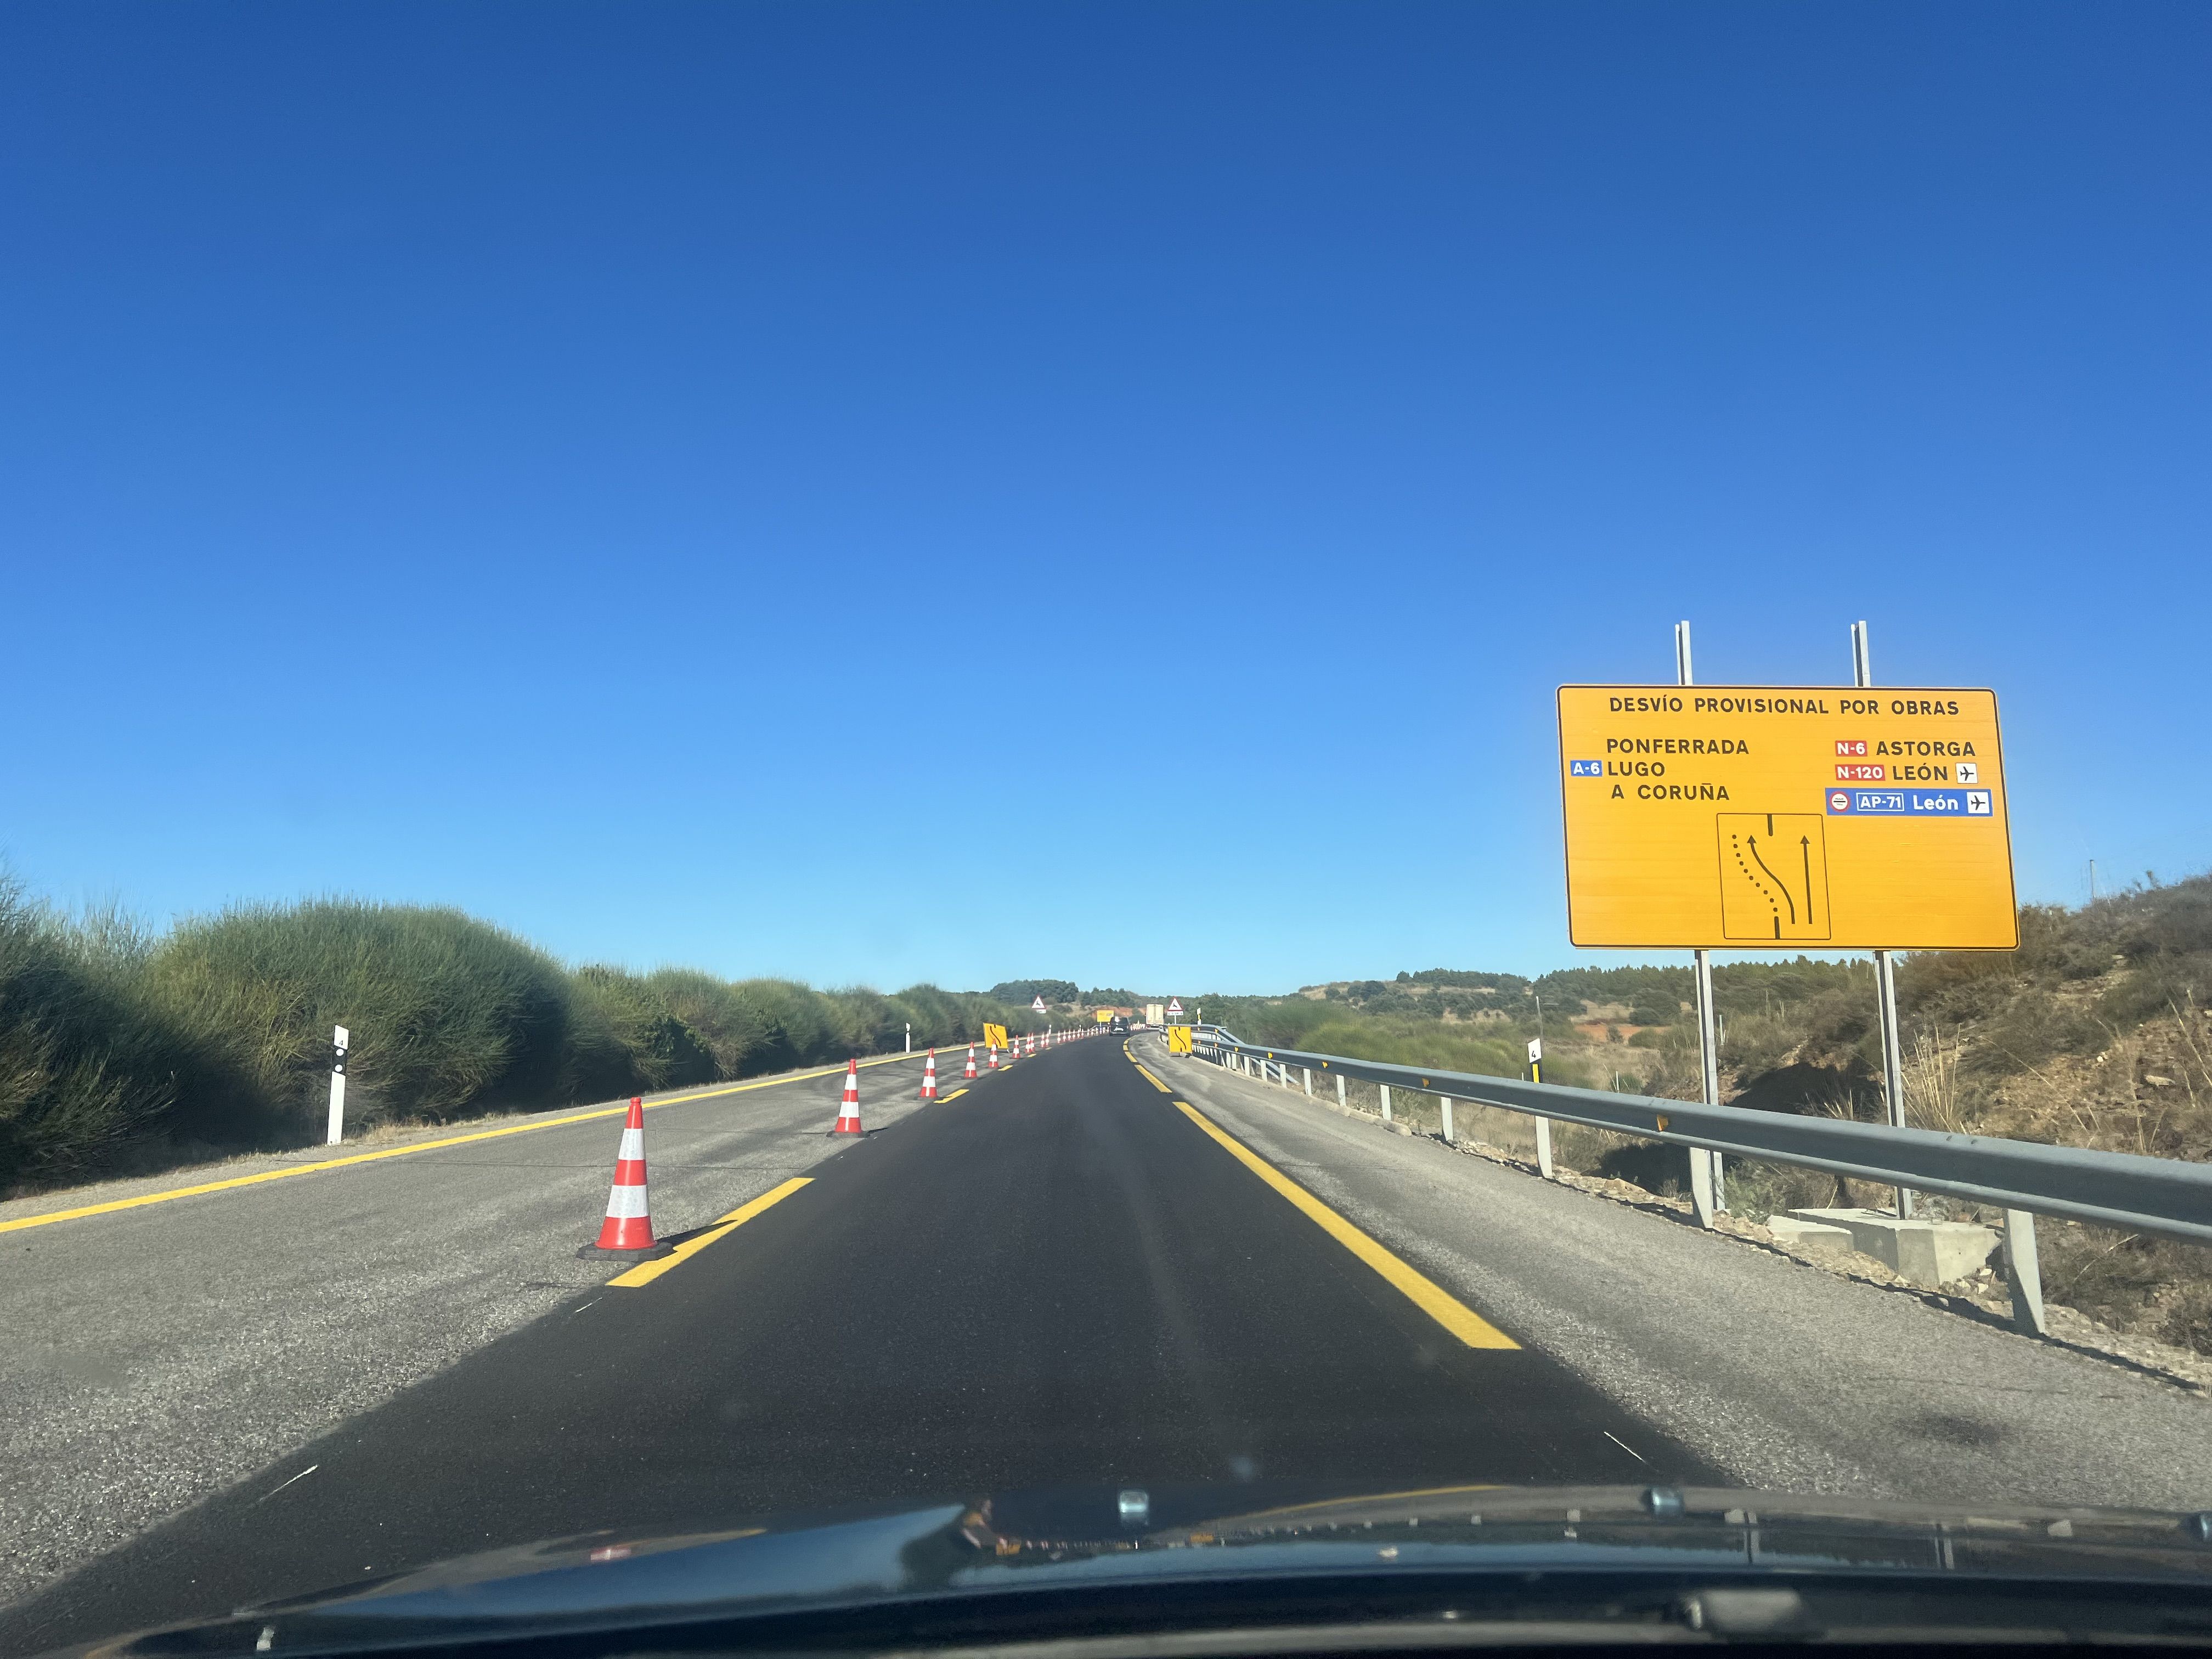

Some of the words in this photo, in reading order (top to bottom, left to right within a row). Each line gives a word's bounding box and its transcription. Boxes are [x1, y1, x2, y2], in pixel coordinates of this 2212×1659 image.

[1610, 695, 1682, 712] DESVÍO
[1695, 698, 1829, 713] PROVISIONAL
[1841, 700, 1879, 714] POR
[1892, 701, 1959, 715] OBRAS
[1607, 739, 1749, 754] PONFERRADA
[1838, 743, 1865, 754] N-6
[1876, 741, 1976, 756] ASTORGA
[1573, 763, 1599, 774] A-6
[1608, 761, 1664, 776] LUGO
[1838, 767, 1882, 778] N-120
[1893, 763, 1948, 780] LEÓN
[1611, 785, 1624, 799] A
[1638, 783, 1729, 800] CORUÑA
[1861, 796, 1900, 808] AP-71
[1914, 795, 1958, 810] León
[1531, 1050, 1537, 1059] 4
